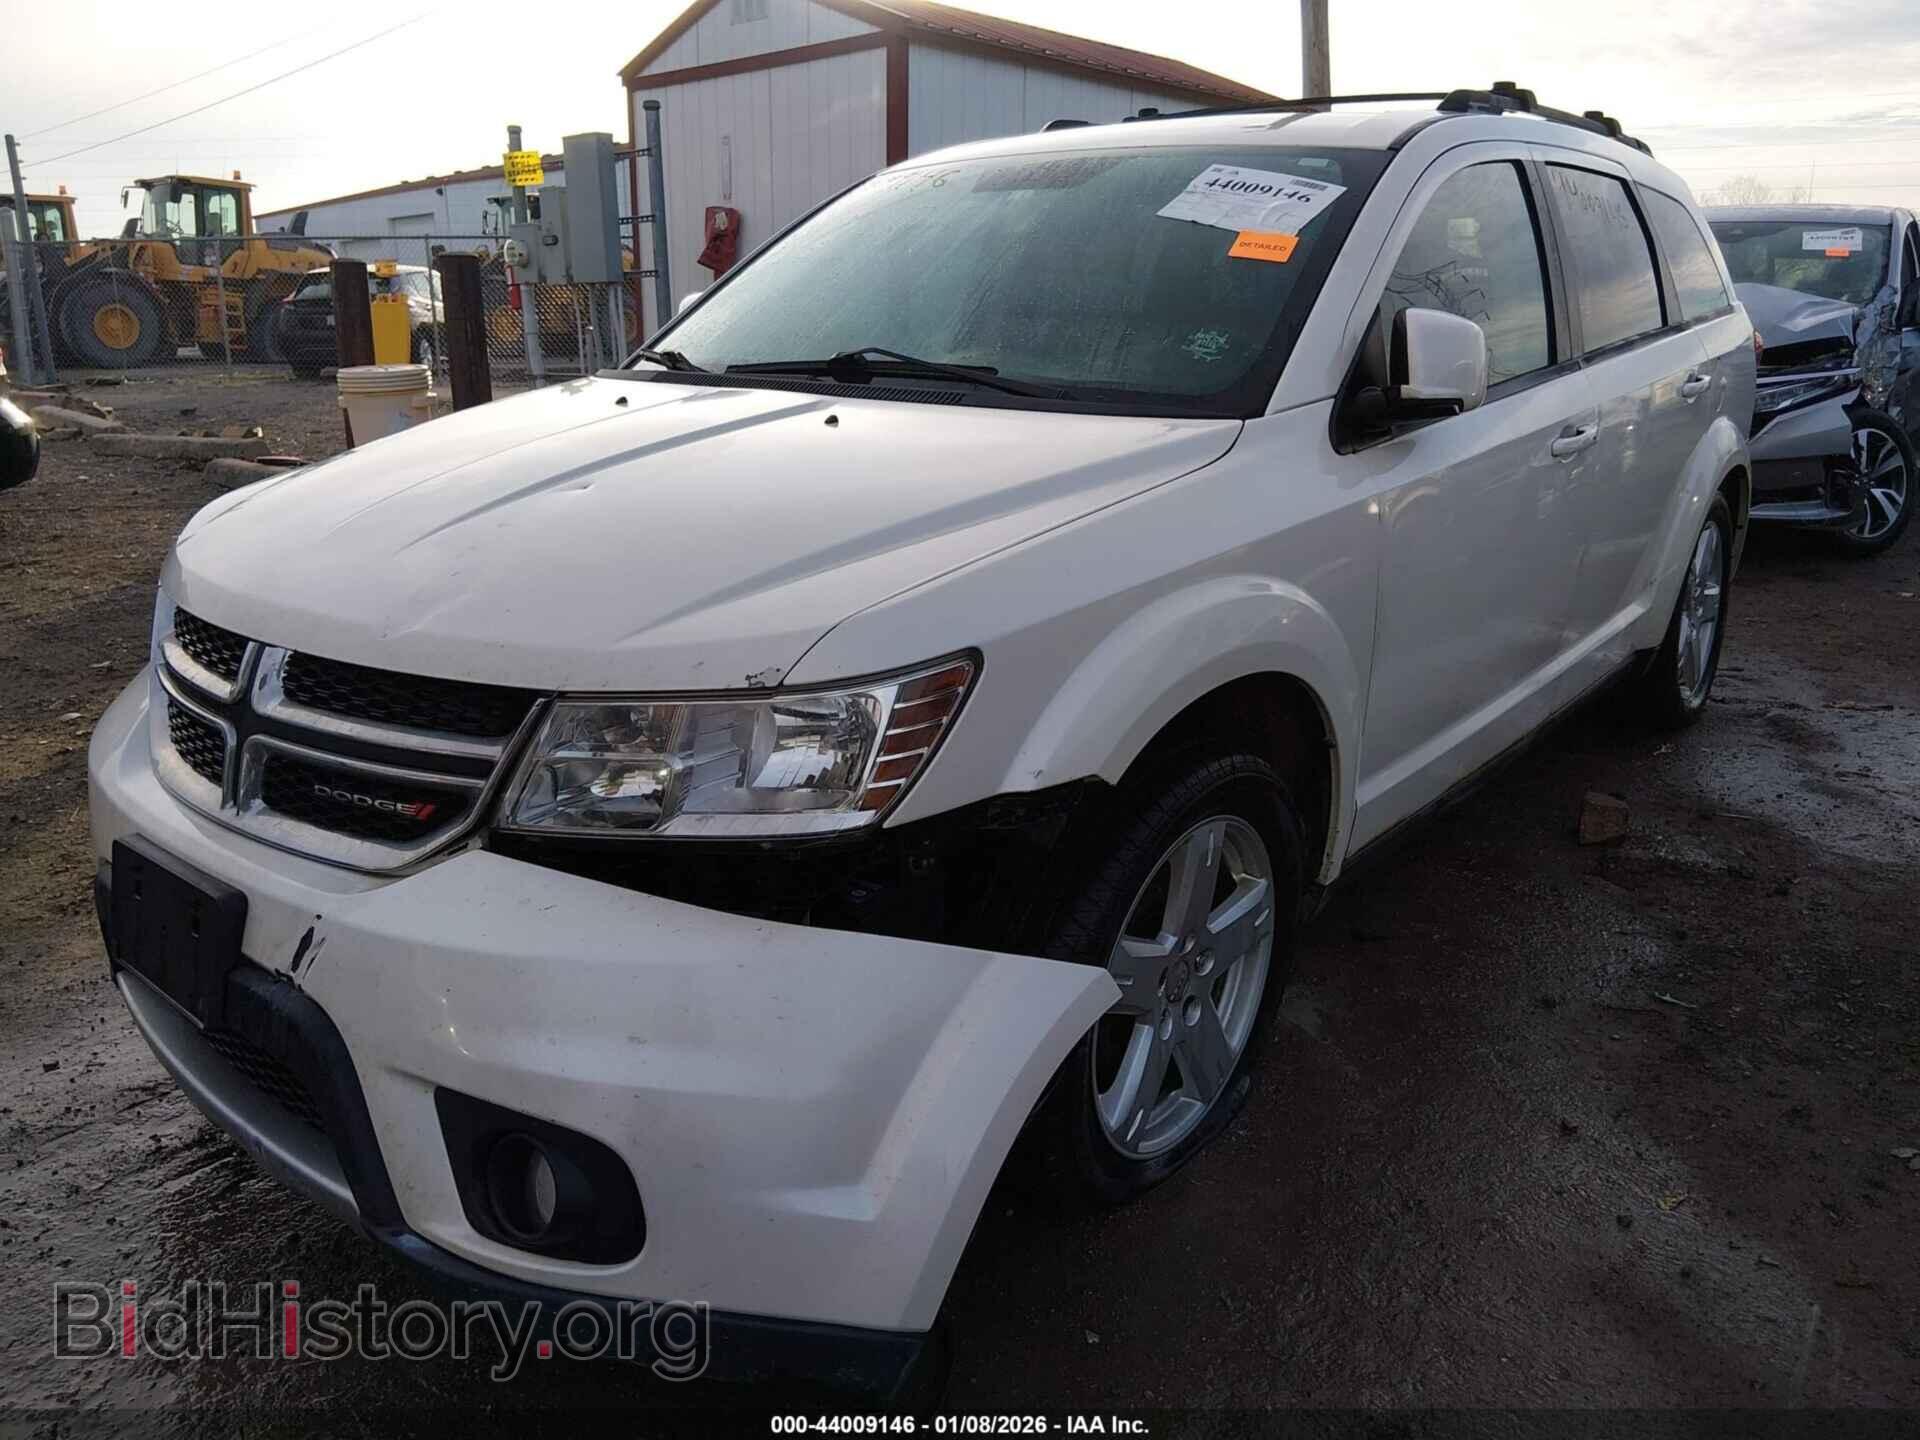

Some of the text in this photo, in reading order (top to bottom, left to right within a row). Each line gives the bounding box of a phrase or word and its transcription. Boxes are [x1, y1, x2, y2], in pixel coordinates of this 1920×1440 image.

[1205, 178, 1311, 203] 44009146
[1239, 241, 1288, 253] DETAILED
[314, 784, 417, 815] DODGE
